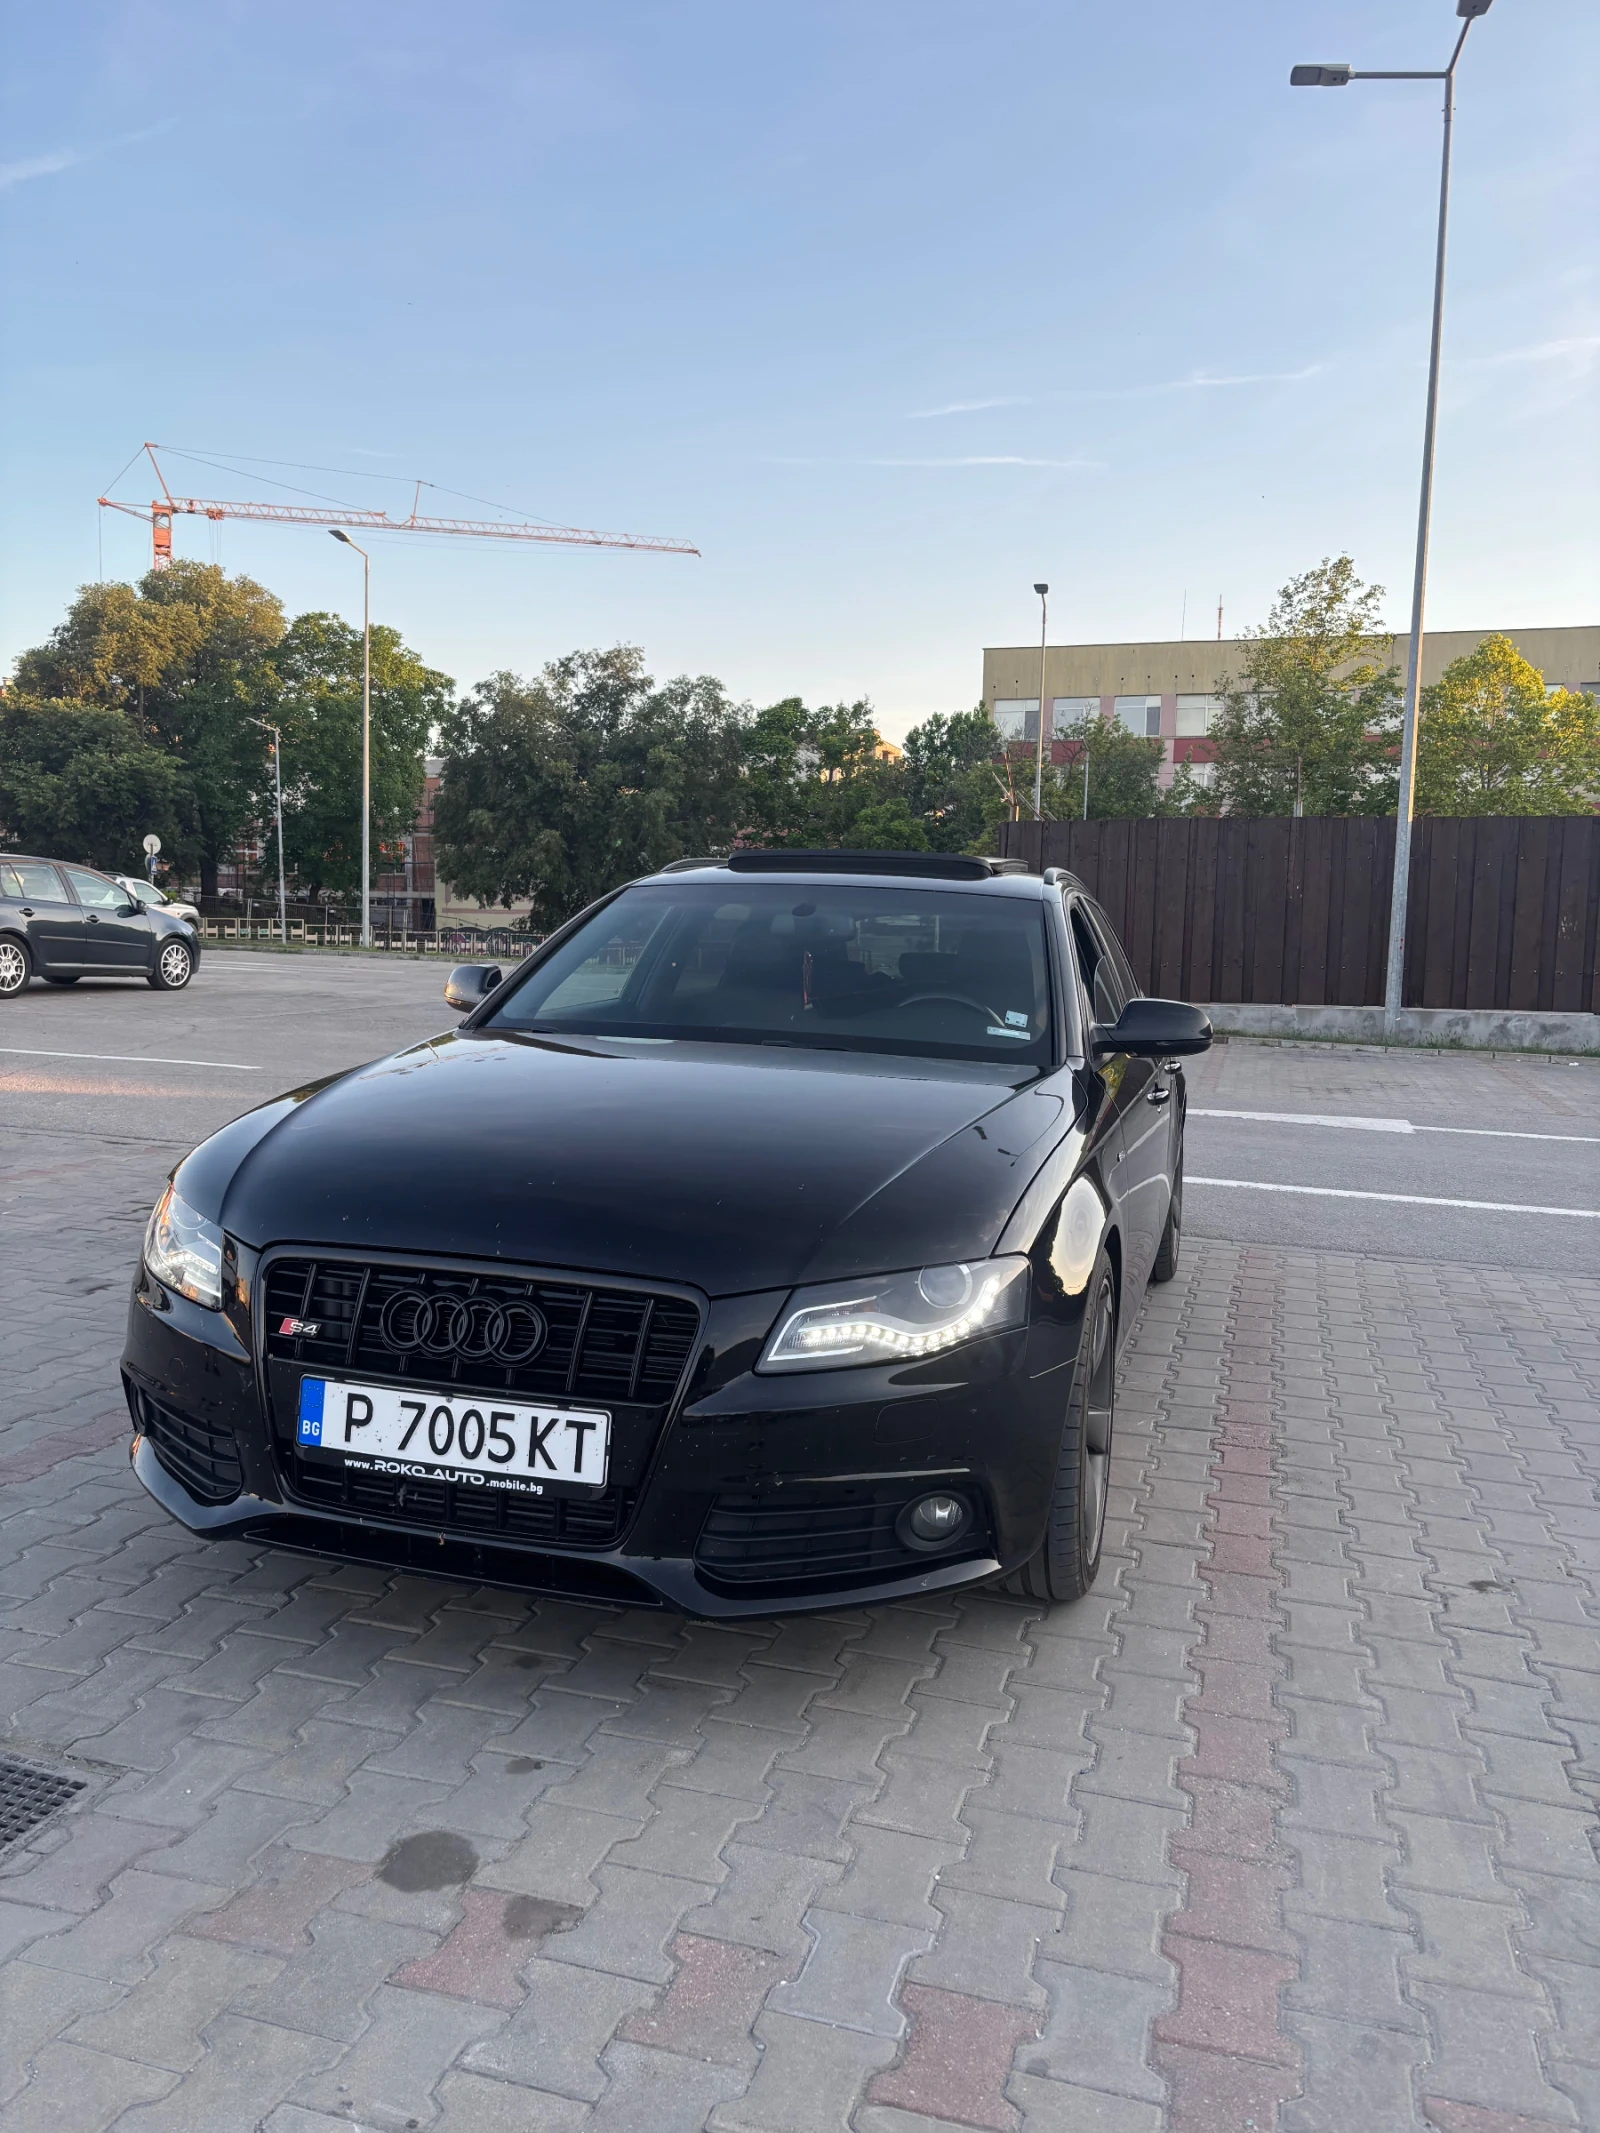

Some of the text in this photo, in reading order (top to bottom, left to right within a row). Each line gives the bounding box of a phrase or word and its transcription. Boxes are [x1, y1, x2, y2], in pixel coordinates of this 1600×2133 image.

[290, 1322, 318, 1336] S4
[302, 1420, 320, 1436] BG
[344, 1393, 597, 1473] P 7005 KT
